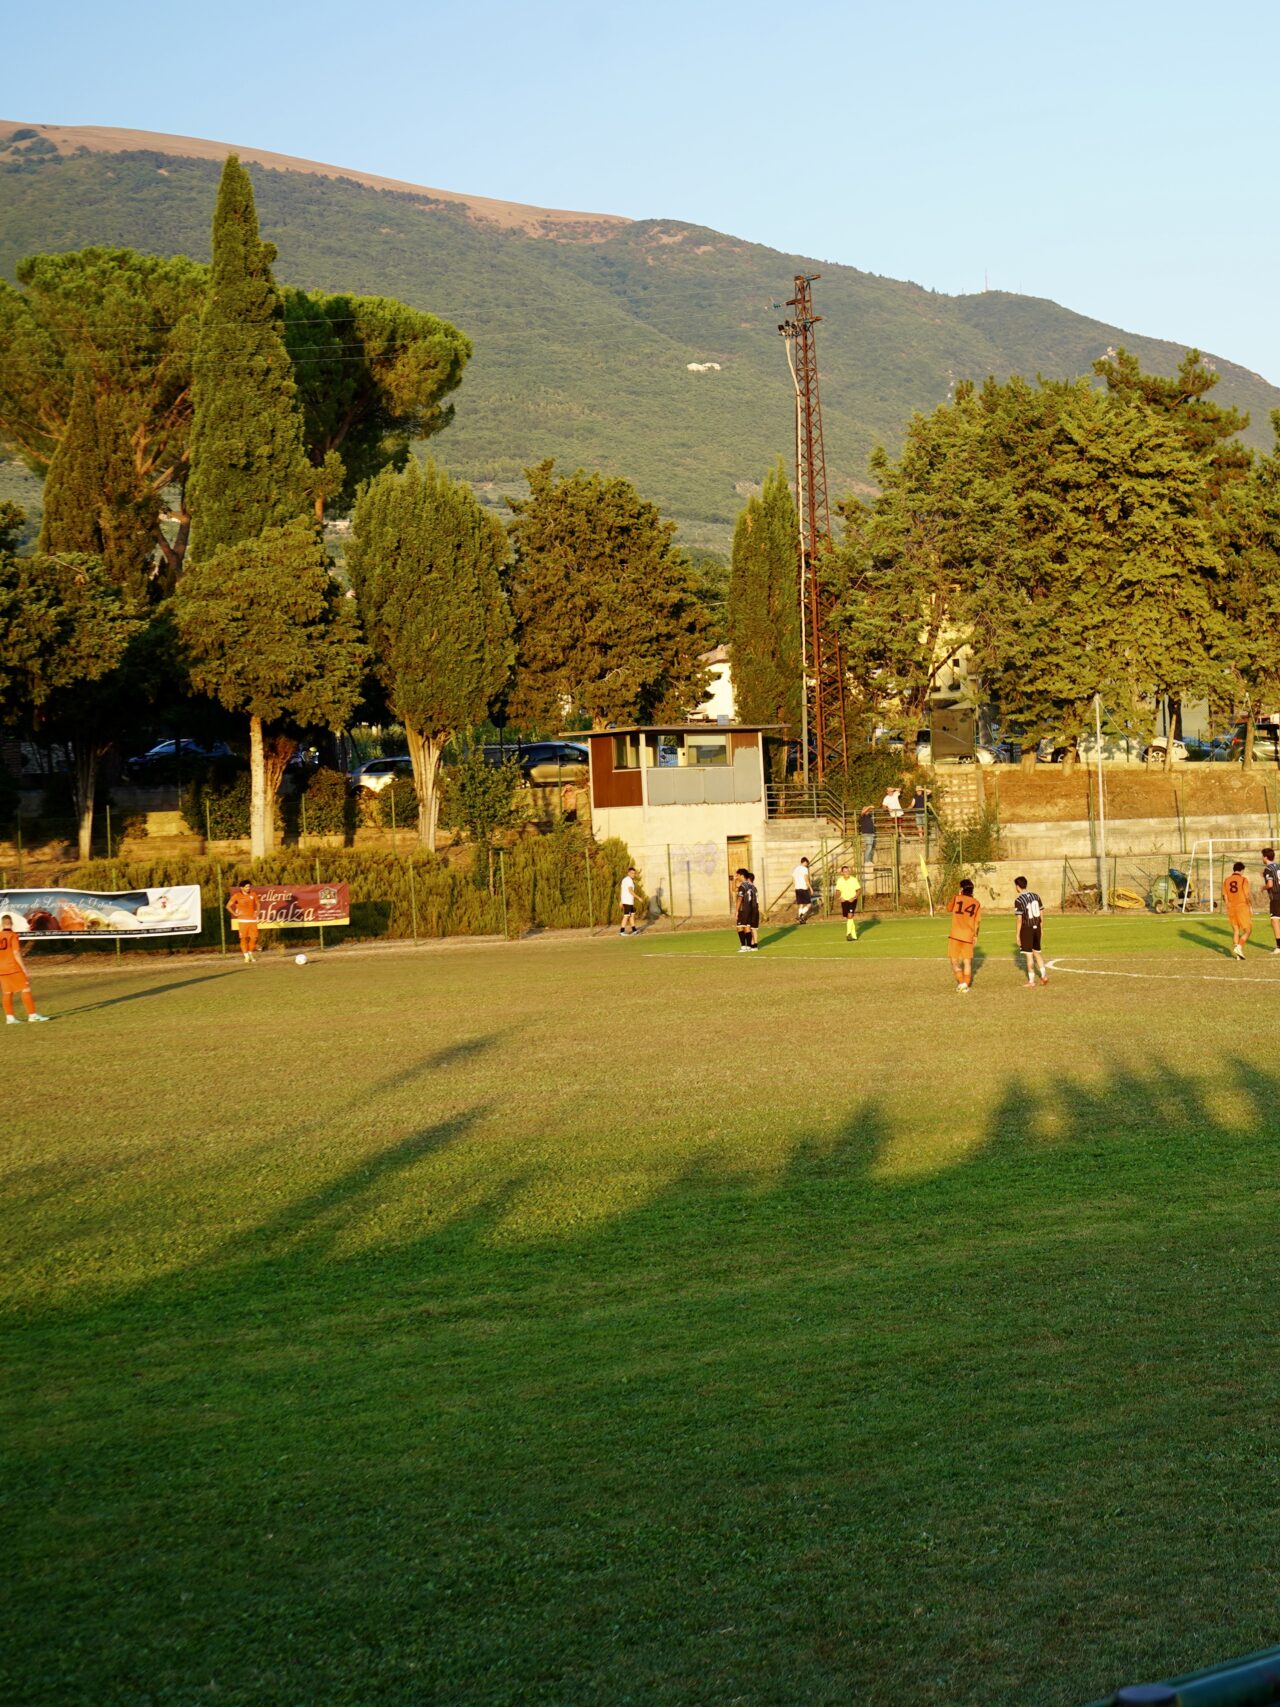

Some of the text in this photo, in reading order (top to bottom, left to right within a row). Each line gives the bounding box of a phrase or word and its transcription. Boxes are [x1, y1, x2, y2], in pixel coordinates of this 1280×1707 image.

[258, 889, 292, 901] elleria
[1229, 881, 1238, 893] 8
[256, 901, 315, 923] abalza
[955, 900, 976, 917] 14
[1026, 900, 1040, 919] 10
